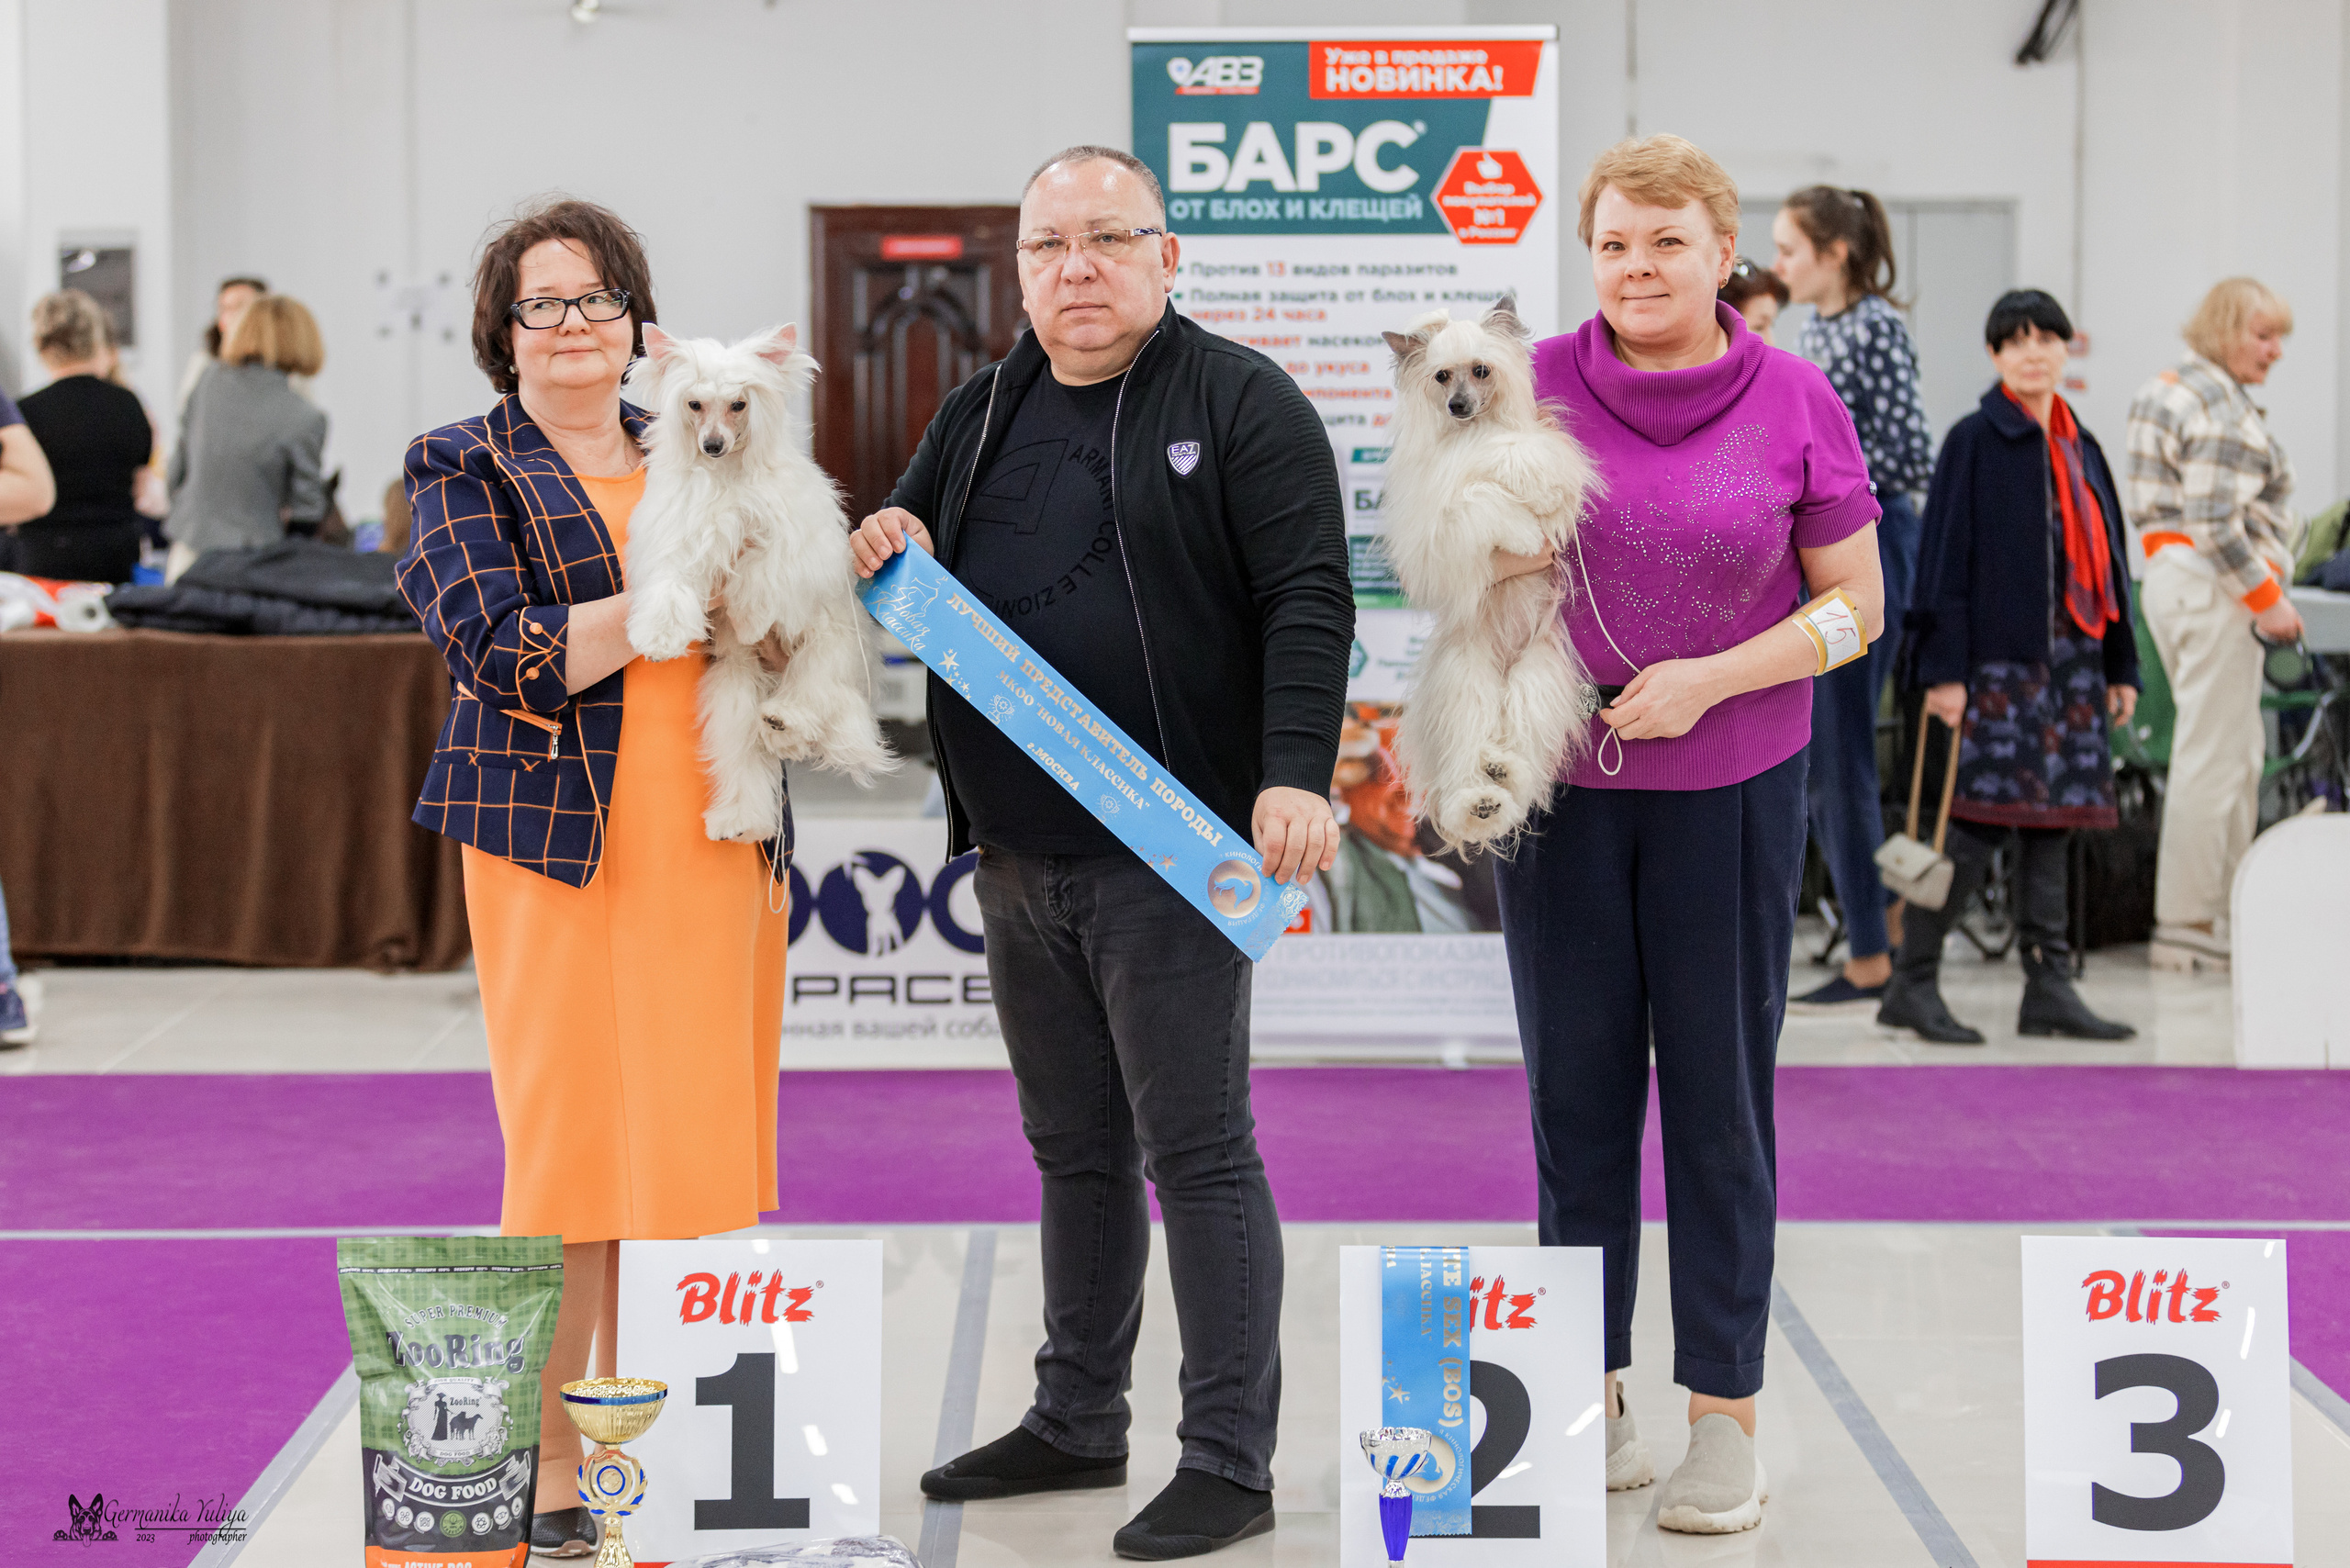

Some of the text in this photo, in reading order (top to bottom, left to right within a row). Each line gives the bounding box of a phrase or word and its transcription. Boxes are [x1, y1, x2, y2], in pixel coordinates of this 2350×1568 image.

[1325, 48, 1488, 67] Уже в продаже
[1326, 65, 1504, 92] НОВИНКА!
[1169, 120, 1420, 194] БАРС
[1169, 194, 1424, 223] ОТ БЛОХ И КЛЕЩЕЙ
[1191, 262, 1458, 278] Против 13 видов паразитов
[1254, 308, 1275, 320] 24
[1282, 309, 1326, 320] часа
[1171, 444, 1196, 454] EA7
[1817, 611, 1856, 644] 15
[995, 670, 1035, 706] МКОО
[946, 592, 1224, 847] ЛУЧШИЙ ПРЕДСТАВИТЕЛЬ ПОРОДЫ
[1026, 742, 1080, 791] г.МОСКВА
[793, 975, 992, 1005] PACE
[405, 1304, 509, 1329] SUPER PREMIUM
[677, 1269, 816, 1327] Blitz
[1470, 1274, 1538, 1332] itz
[2081, 1268, 2222, 1326] Blitz
[1443, 1296, 1461, 1347] SEX
[386, 1330, 525, 1374] ZooRing
[450, 1396, 480, 1407] ZooRing
[1438, 1357, 1464, 1428] (BOS)
[693, 1352, 810, 1530] 1
[1409, 1360, 1540, 1539] 2
[2091, 1352, 2225, 1531] 3
[408, 1476, 498, 1500] DOG FOOD
